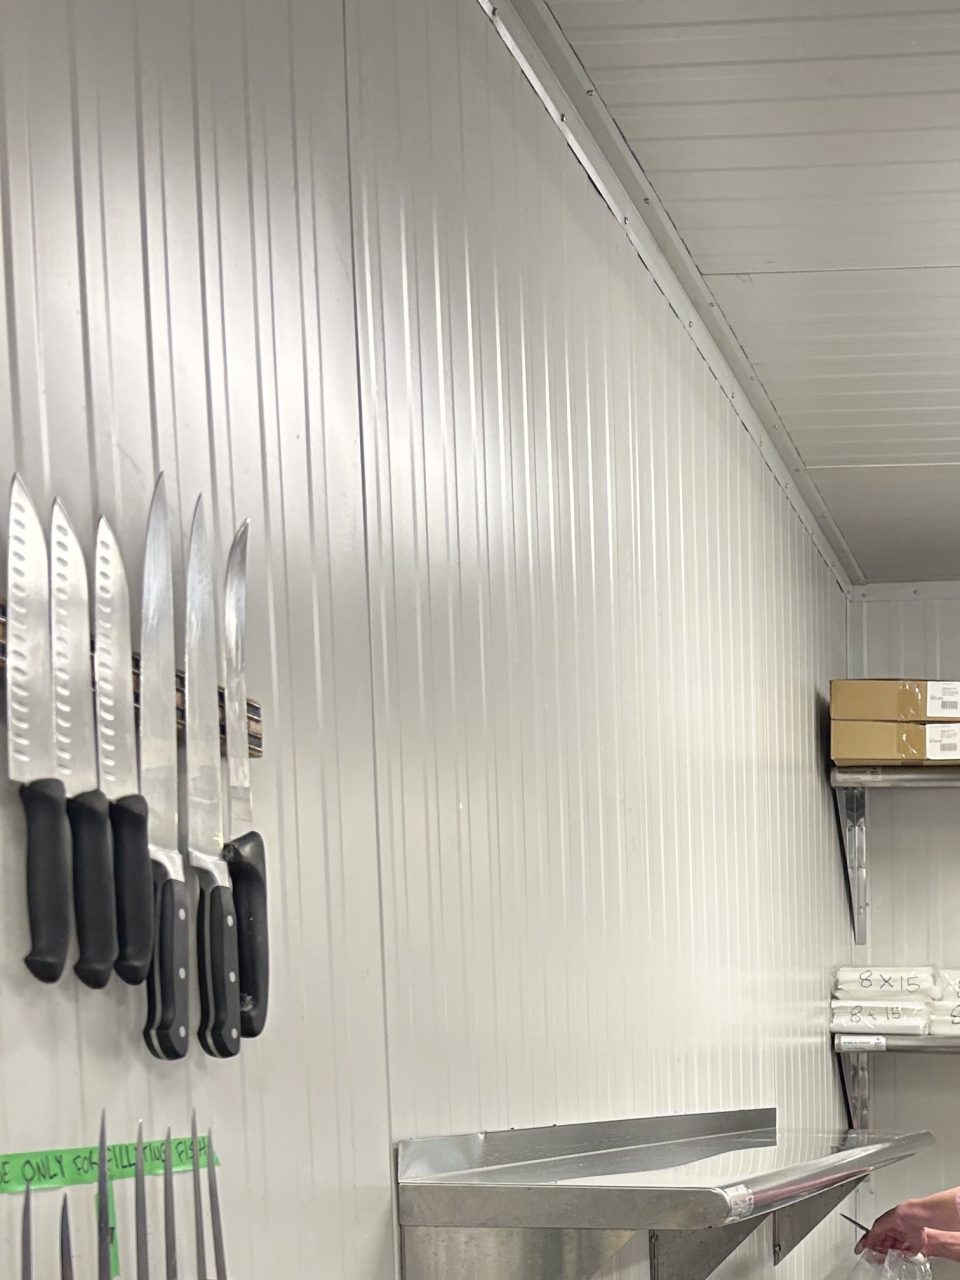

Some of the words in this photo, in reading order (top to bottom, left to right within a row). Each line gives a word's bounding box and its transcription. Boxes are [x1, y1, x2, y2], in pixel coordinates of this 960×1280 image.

[859, 970, 873, 989] 8
[900, 974, 921, 993] 15
[850, 1005, 863, 1023] 8
[885, 1006, 901, 1020] 15
[21, 1154, 66, 1182] ONLY
